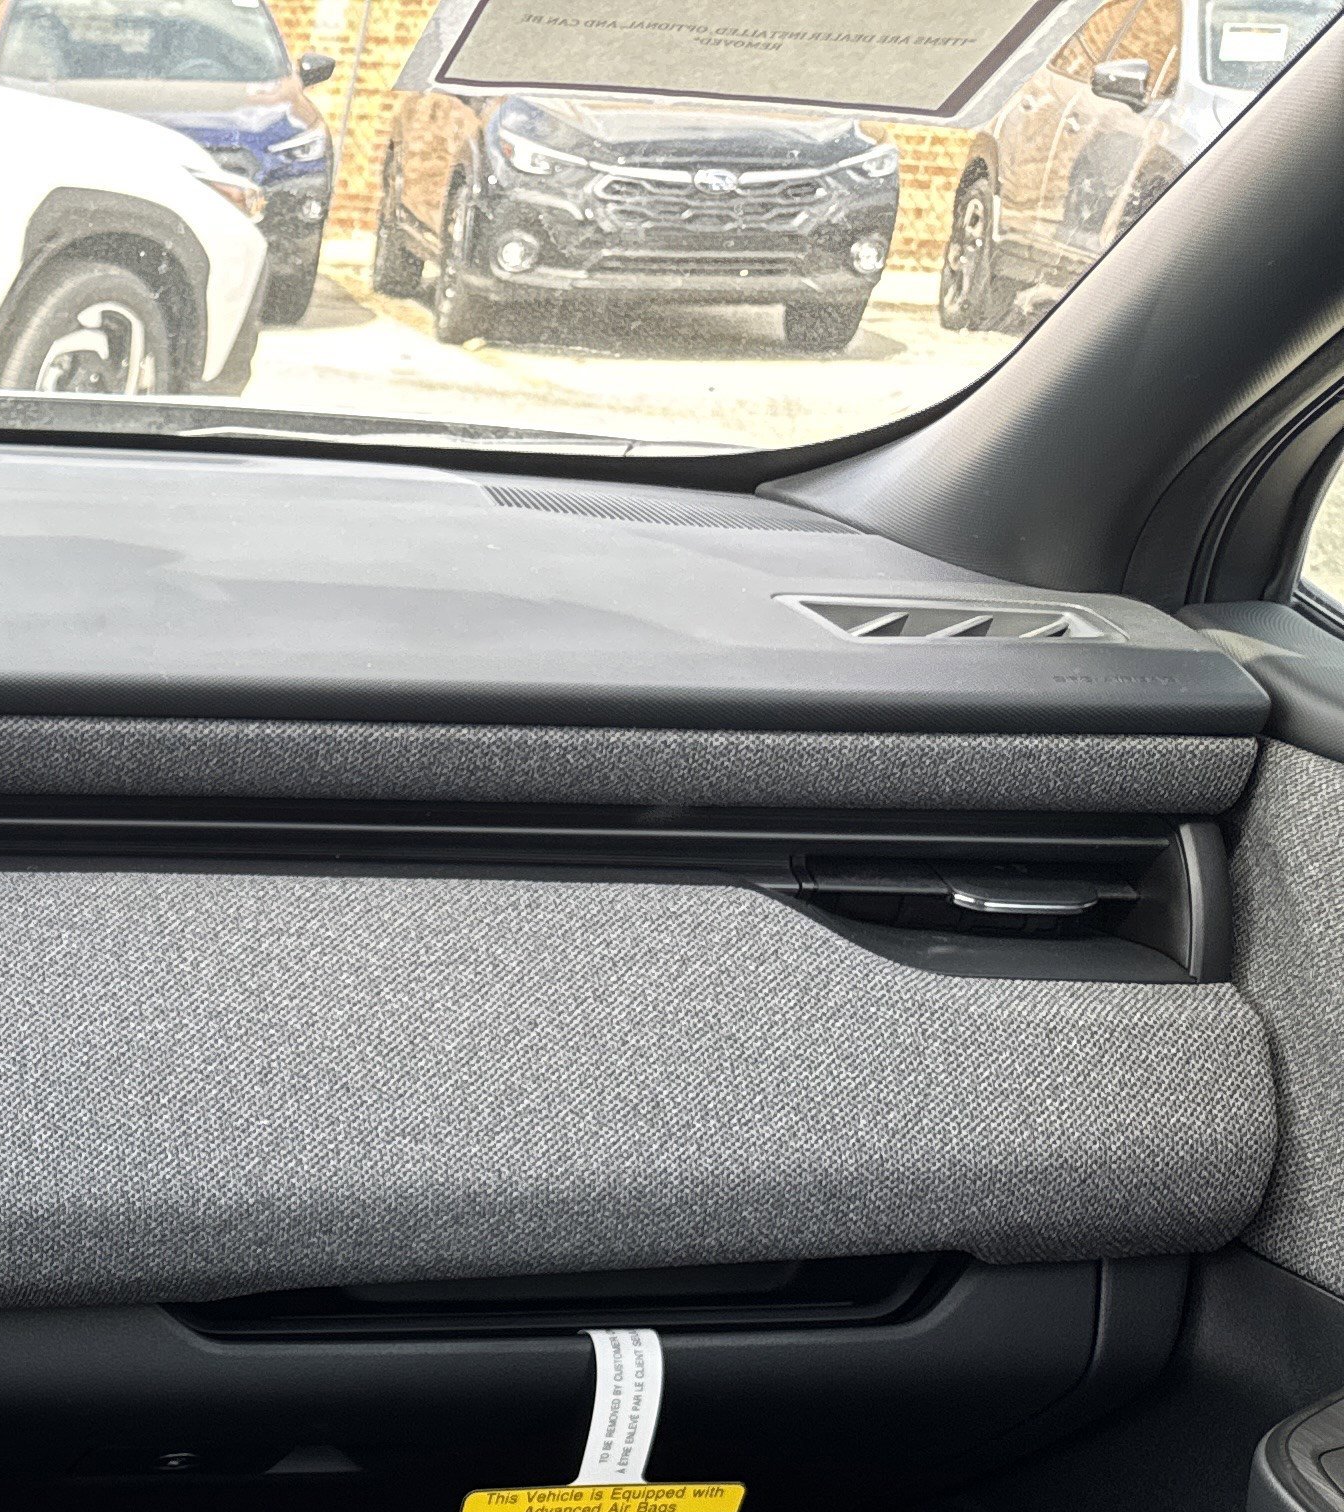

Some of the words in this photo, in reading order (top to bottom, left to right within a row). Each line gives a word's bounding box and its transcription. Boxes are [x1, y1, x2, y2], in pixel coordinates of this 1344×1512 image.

[486, 1492, 518, 1505] This
[527, 1490, 584, 1503] Vehicle
[590, 1489, 603, 1501] is
[610, 1486, 687, 1503] Equipped
[692, 1486, 725, 1498] with
